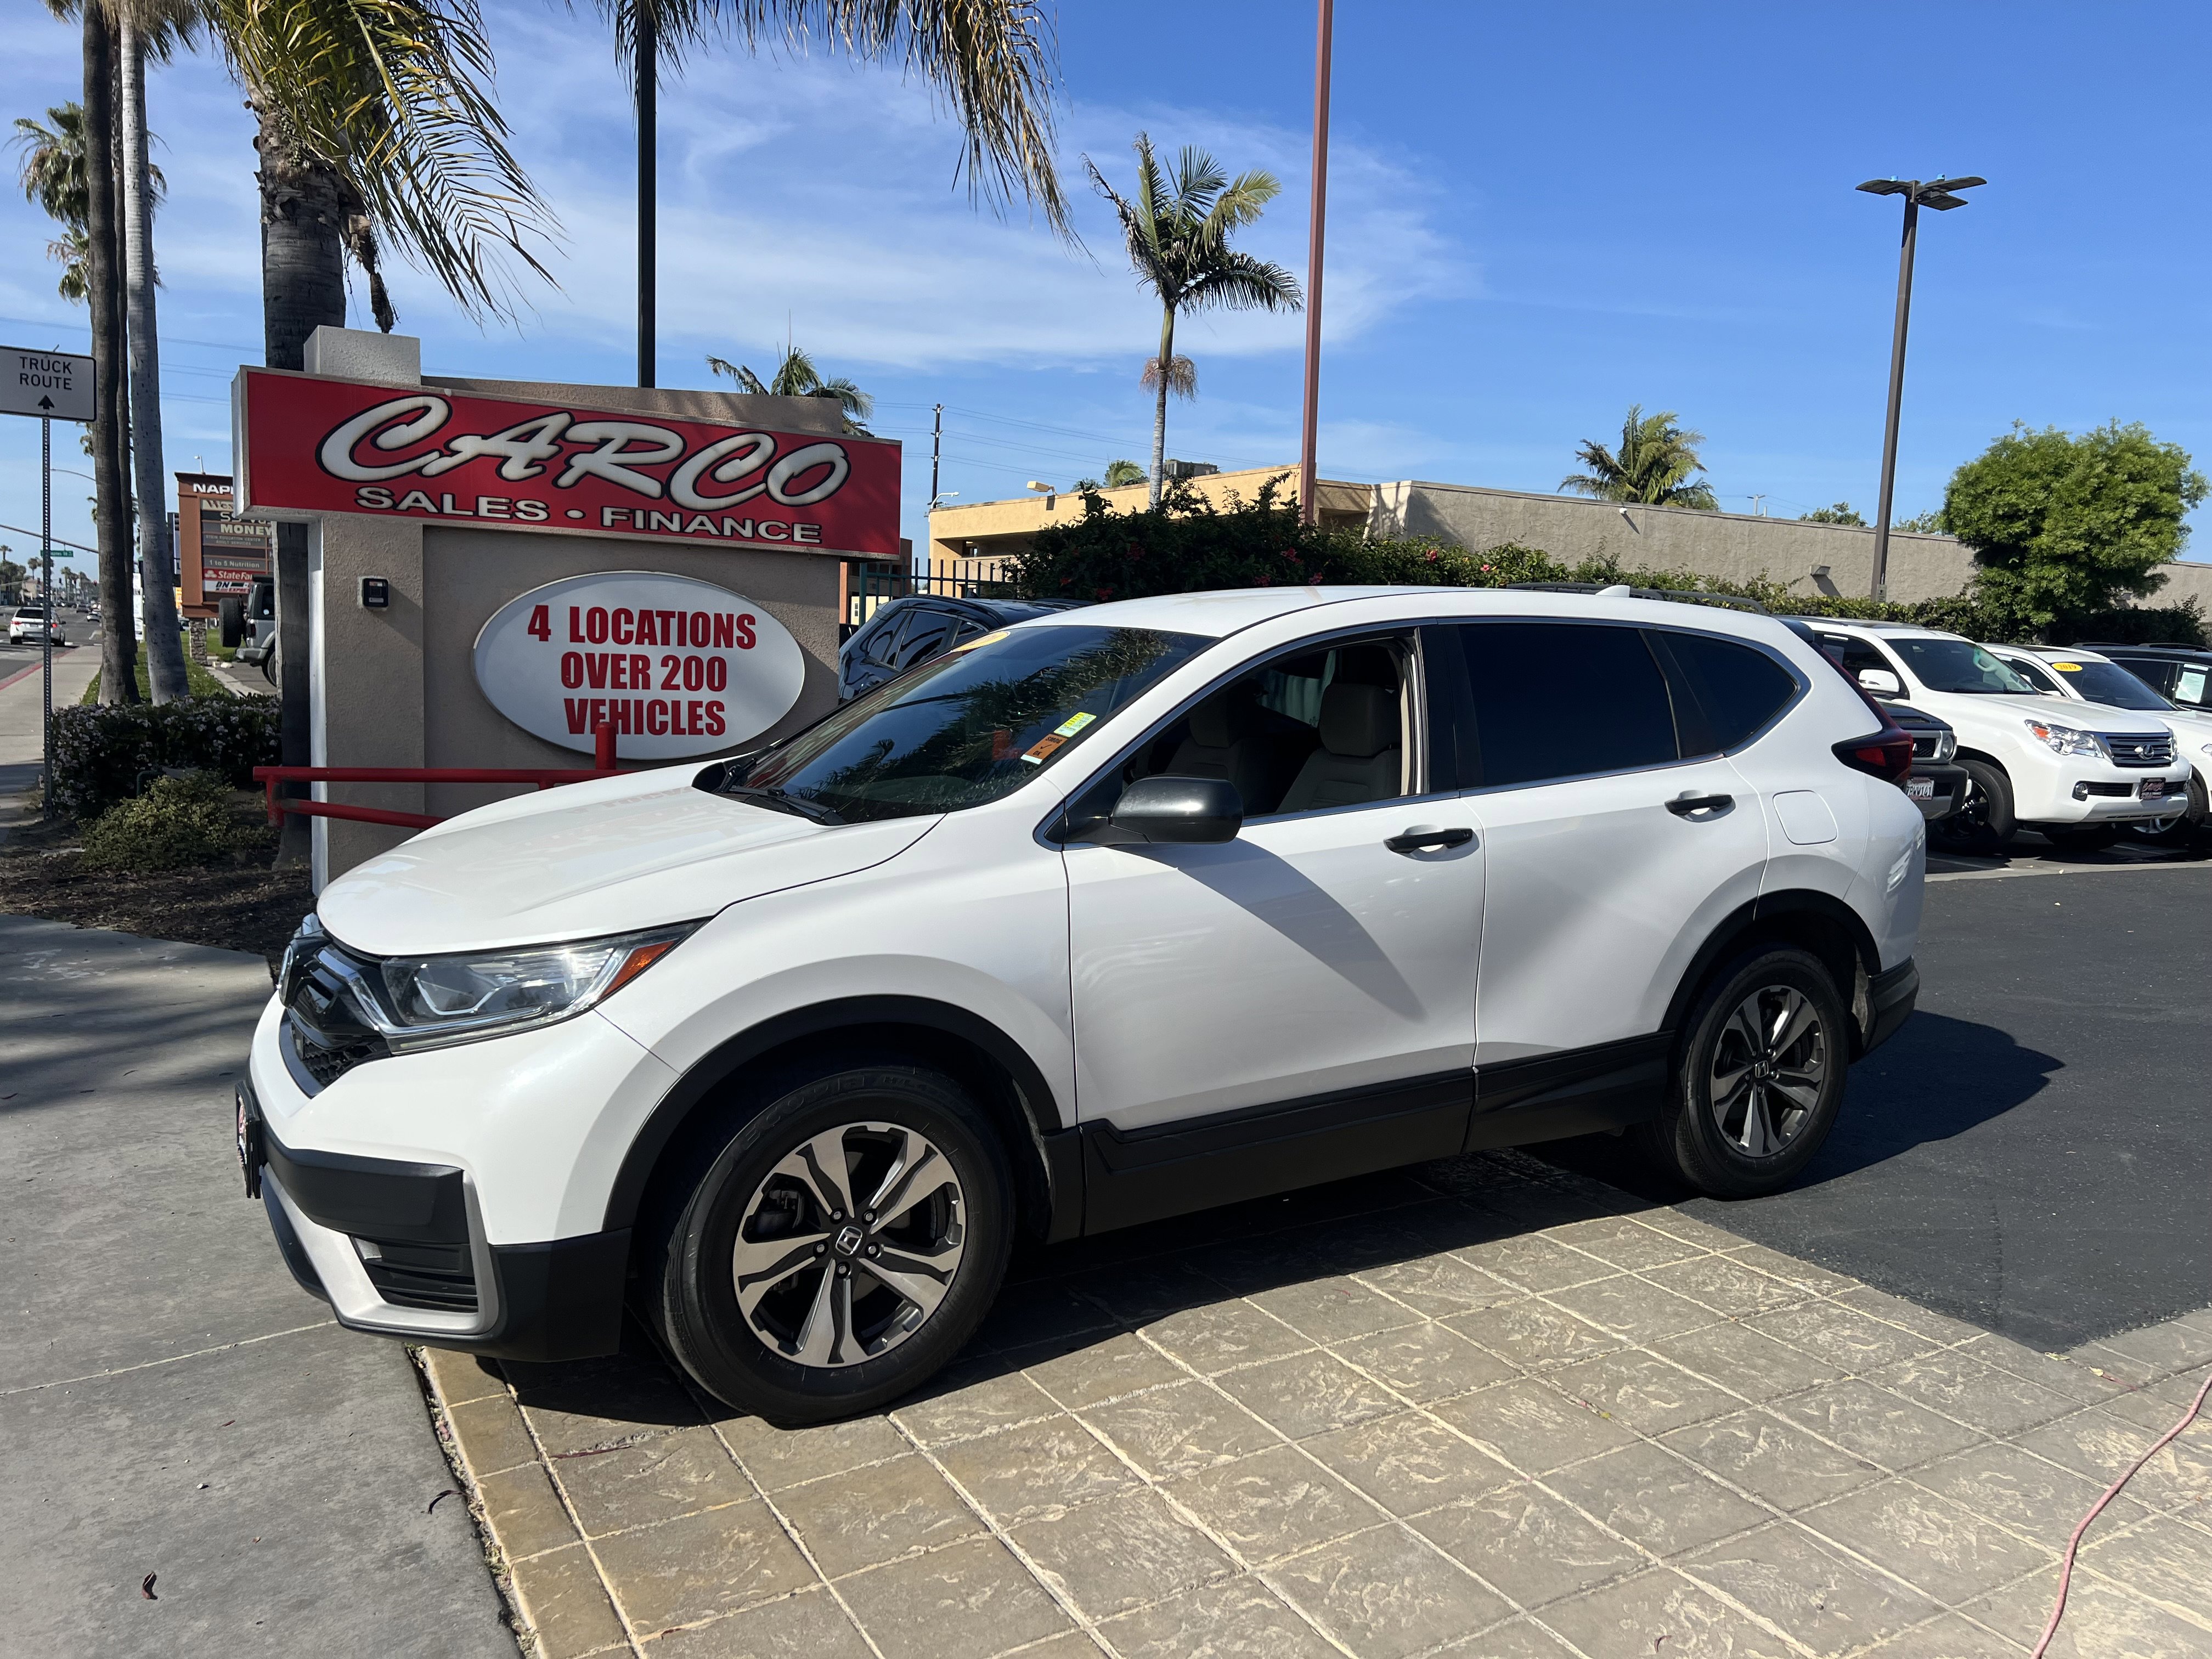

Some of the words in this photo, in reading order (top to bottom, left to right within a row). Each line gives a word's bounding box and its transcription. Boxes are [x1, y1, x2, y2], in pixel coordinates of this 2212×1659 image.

[19, 357, 72, 374] TRUCK
[20, 373, 72, 391] ROUTE
[317, 394, 851, 510] CARCO
[221, 524, 272, 536] MONEY
[356, 485, 550, 522] SALES
[601, 506, 823, 544] FINANCE
[528, 605, 551, 641] 4
[569, 606, 757, 650] LOCATIONS
[561, 652, 651, 690] OVER
[661, 655, 727, 692] 200
[564, 698, 726, 736] VEHICLES
